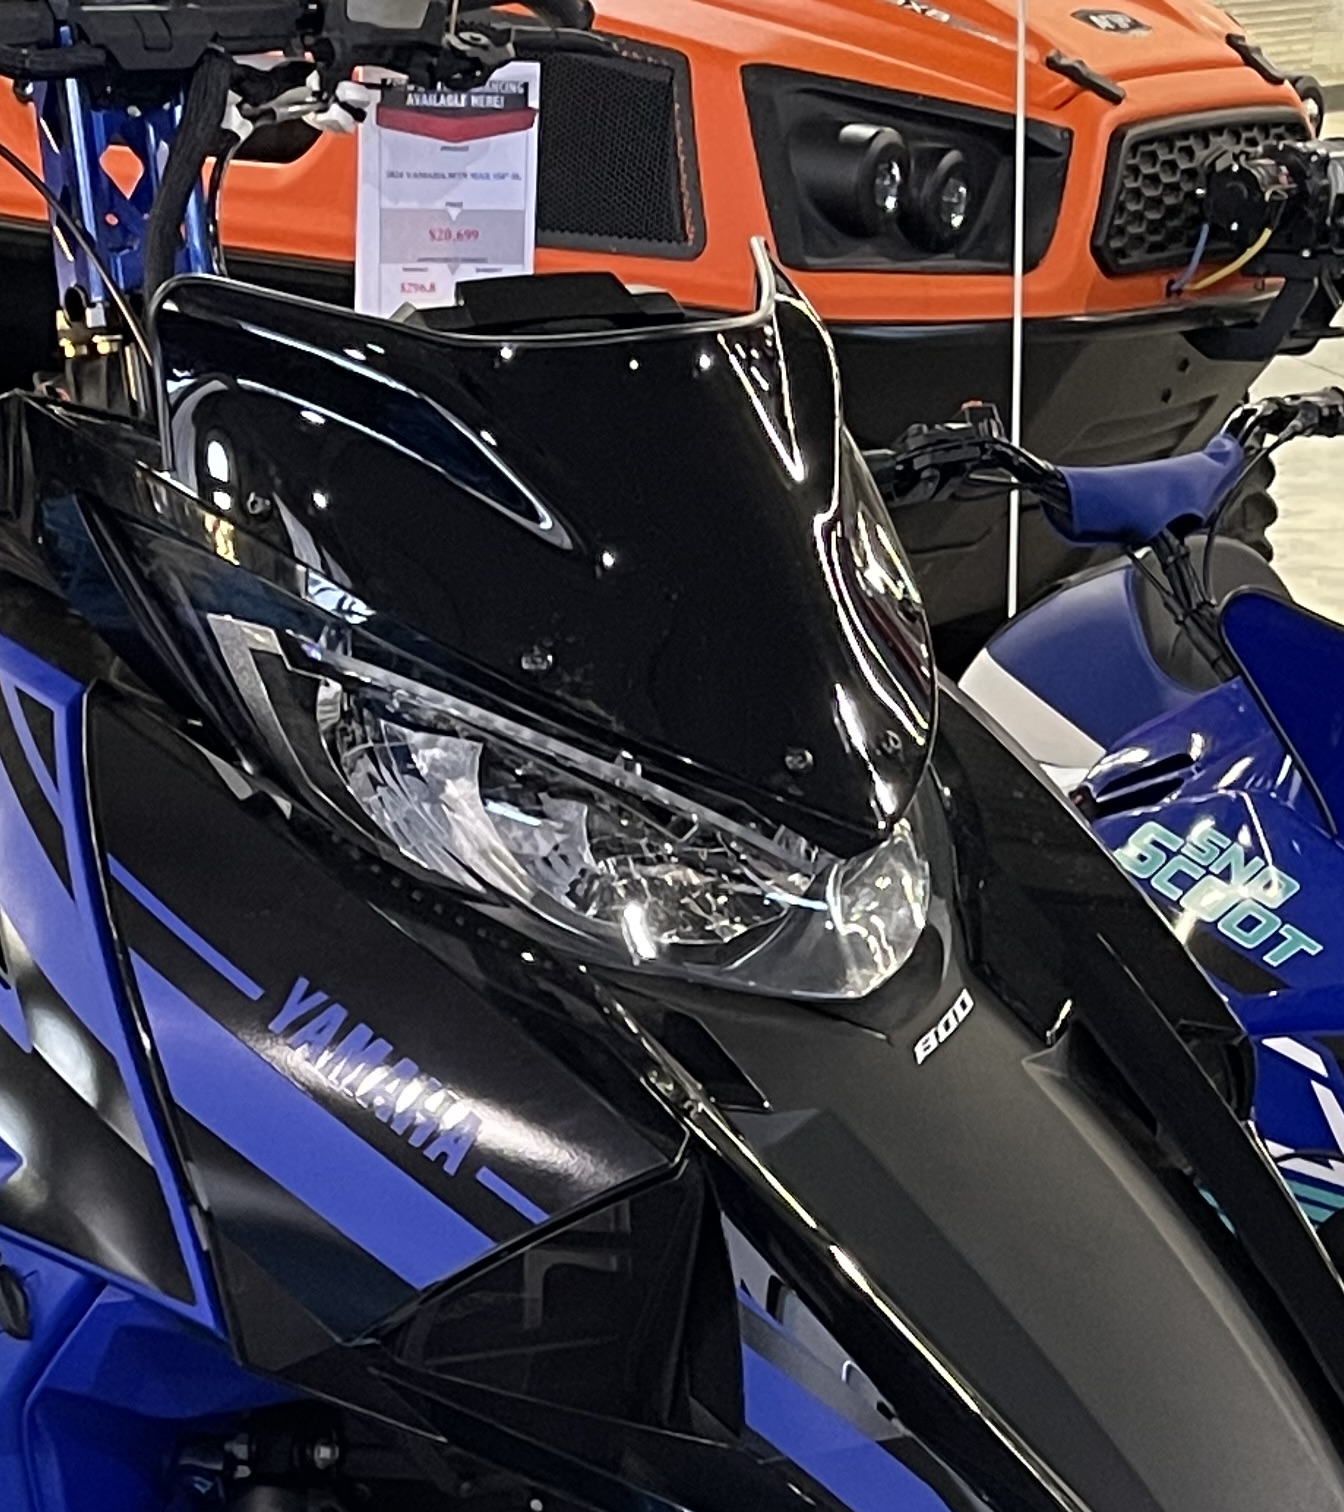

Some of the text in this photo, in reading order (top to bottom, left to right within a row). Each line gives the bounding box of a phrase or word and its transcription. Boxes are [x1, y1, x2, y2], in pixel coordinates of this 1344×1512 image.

[406, 92, 467, 108] AVAILABLE
[1113, 820, 1324, 967] SCOOT
[1180, 822, 1301, 909] SNO
[914, 987, 975, 1065] 800
[267, 975, 483, 1177] YAMAHA
